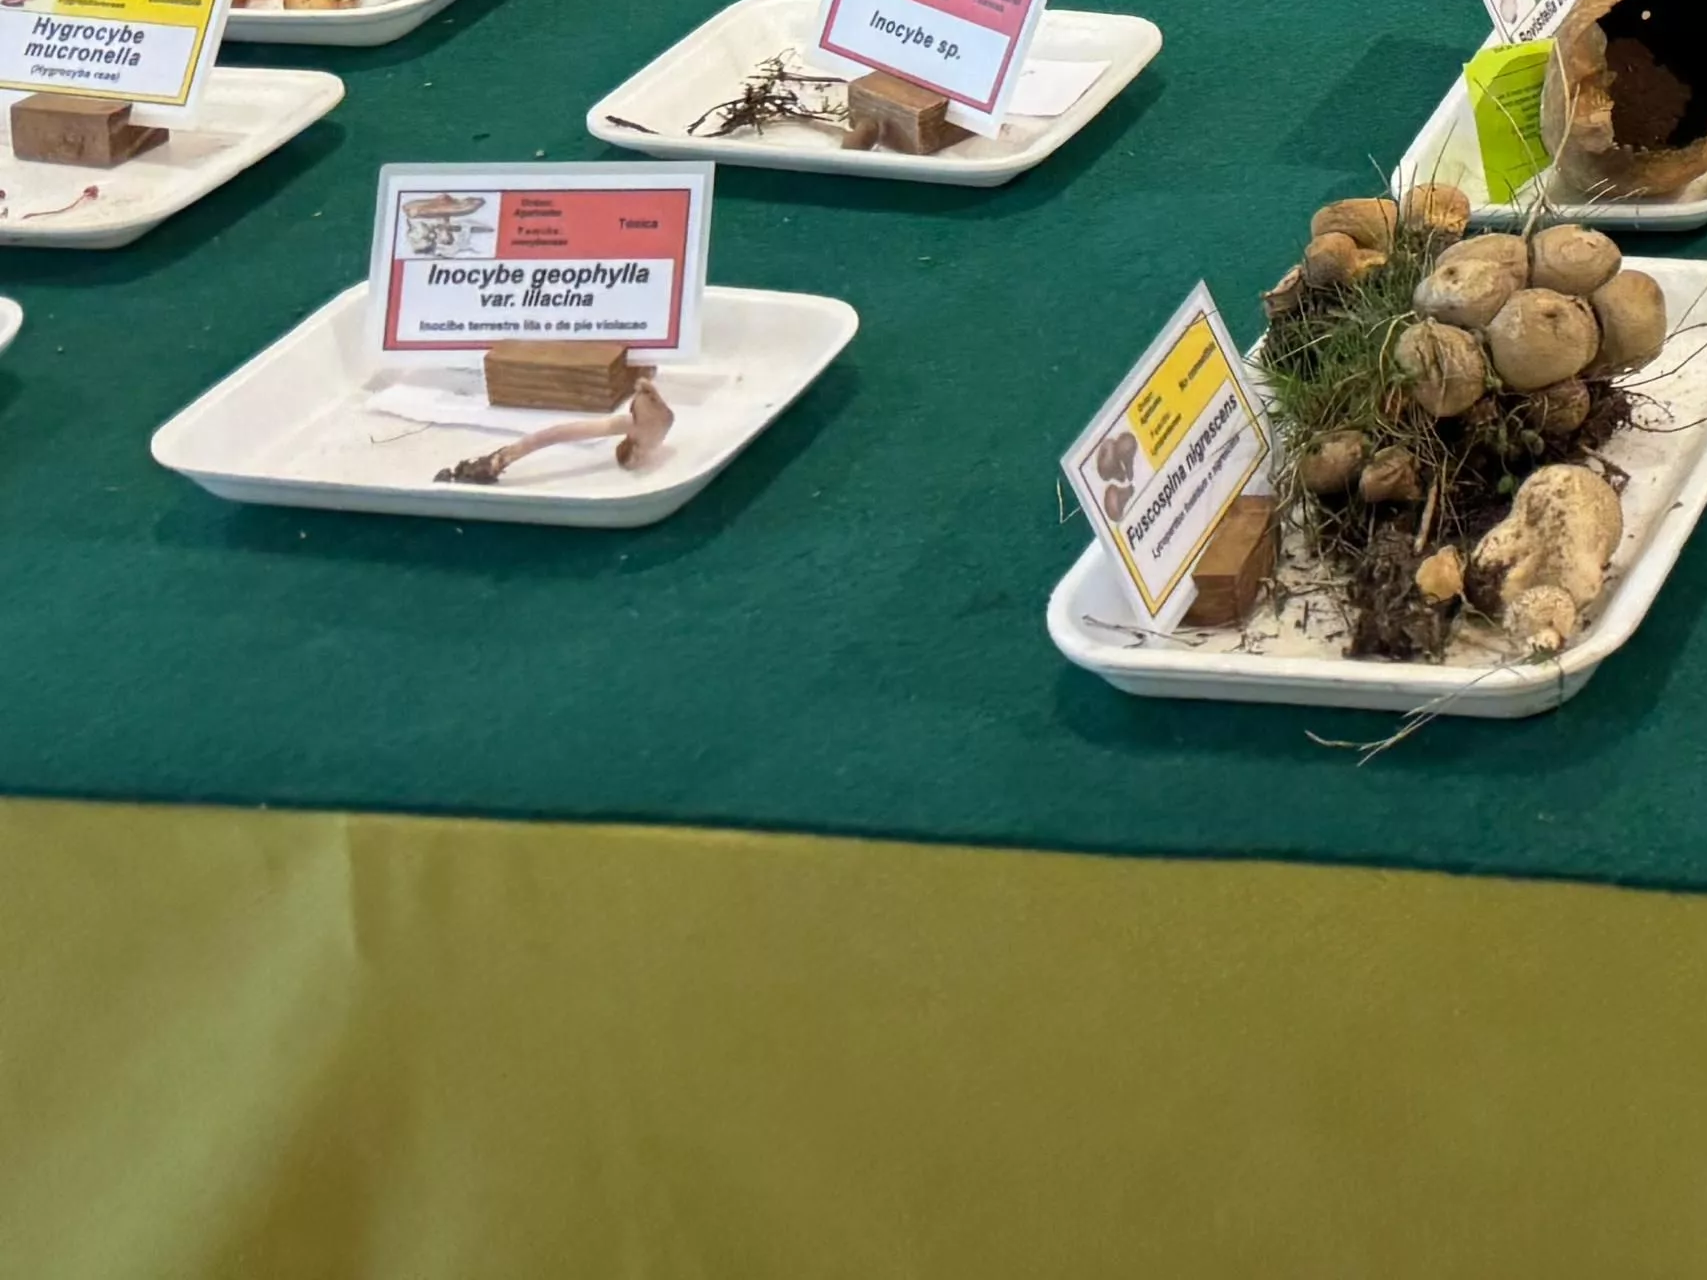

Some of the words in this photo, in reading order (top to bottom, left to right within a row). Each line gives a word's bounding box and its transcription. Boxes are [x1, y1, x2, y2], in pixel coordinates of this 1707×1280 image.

[32, 16, 145, 45] Hygrocybe
[869, 9, 934, 50] Inocybe
[937, 37, 961, 60] sp.
[24, 41, 141, 67] mucronella
[428, 263, 524, 289] Inocybe
[531, 262, 650, 289] geophylla
[480, 291, 515, 308] var.
[522, 289, 594, 307] lilacina
[1126, 465, 1187, 552] Fuscospina
[1185, 393, 1238, 474] nigrescens
